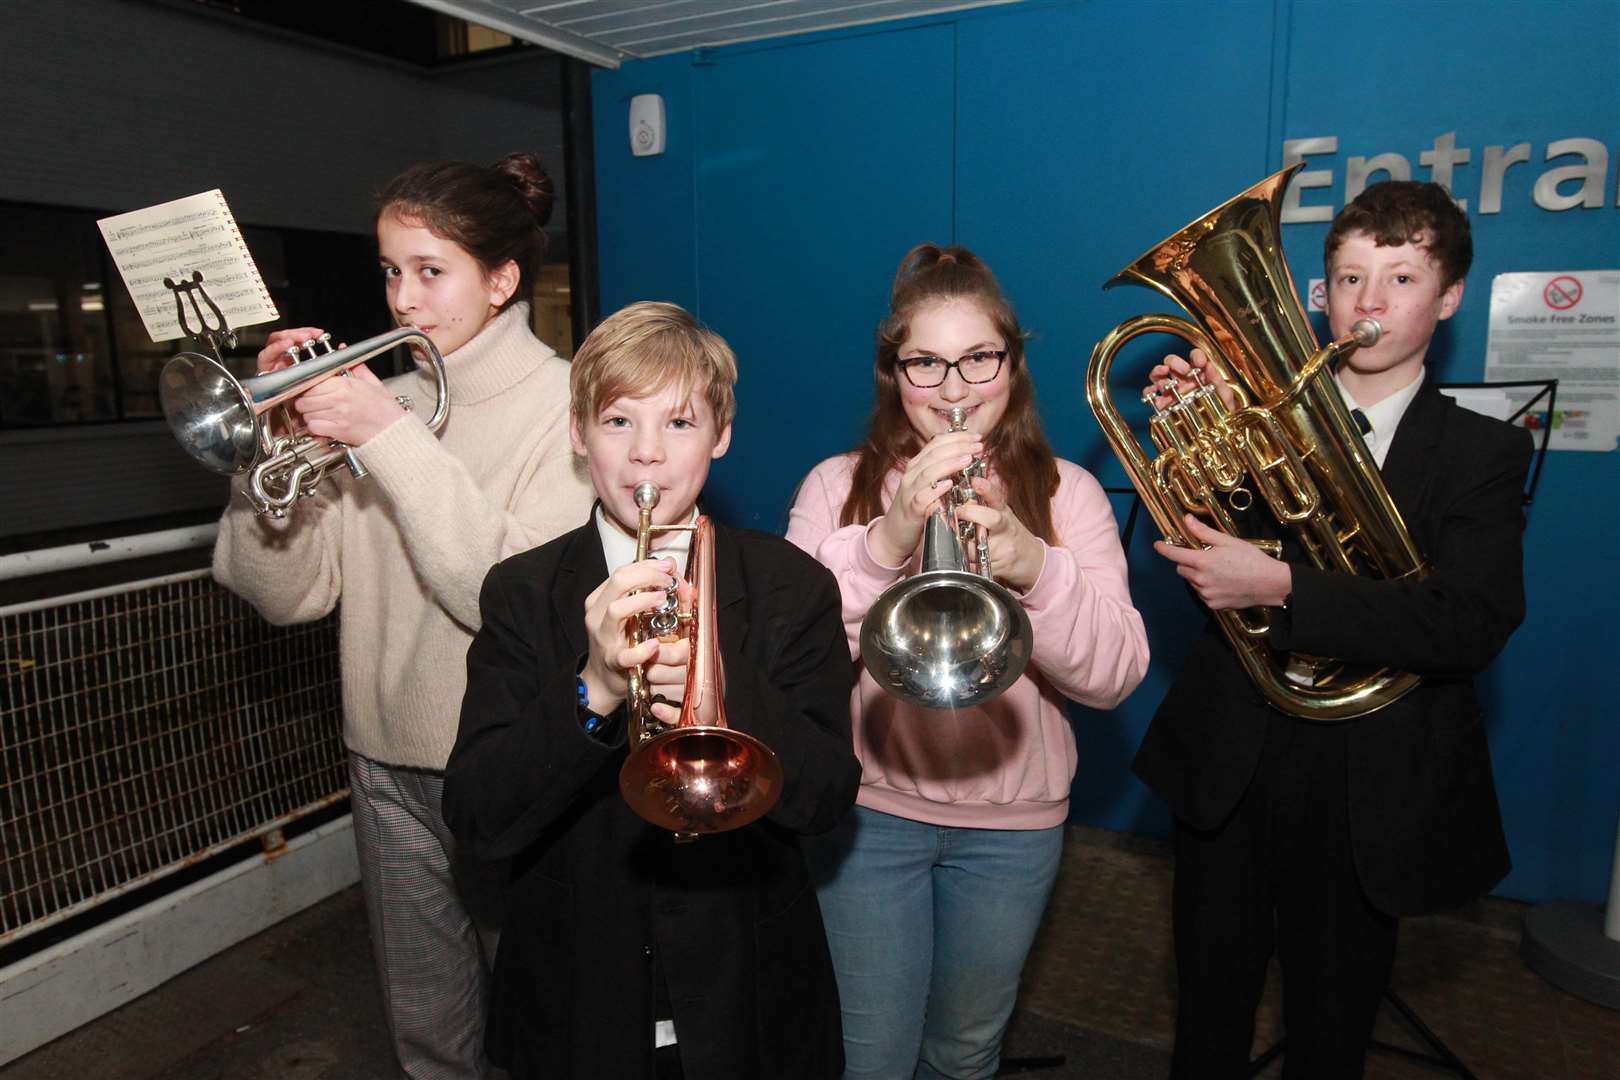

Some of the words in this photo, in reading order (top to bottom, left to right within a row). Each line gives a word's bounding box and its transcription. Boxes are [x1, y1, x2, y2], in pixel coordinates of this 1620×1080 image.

[1281, 131, 1620, 223] Entra
[1507, 315, 1547, 324] Smoke
[1550, 314, 1576, 323] Free
[1579, 314, 1616, 323] Zones
